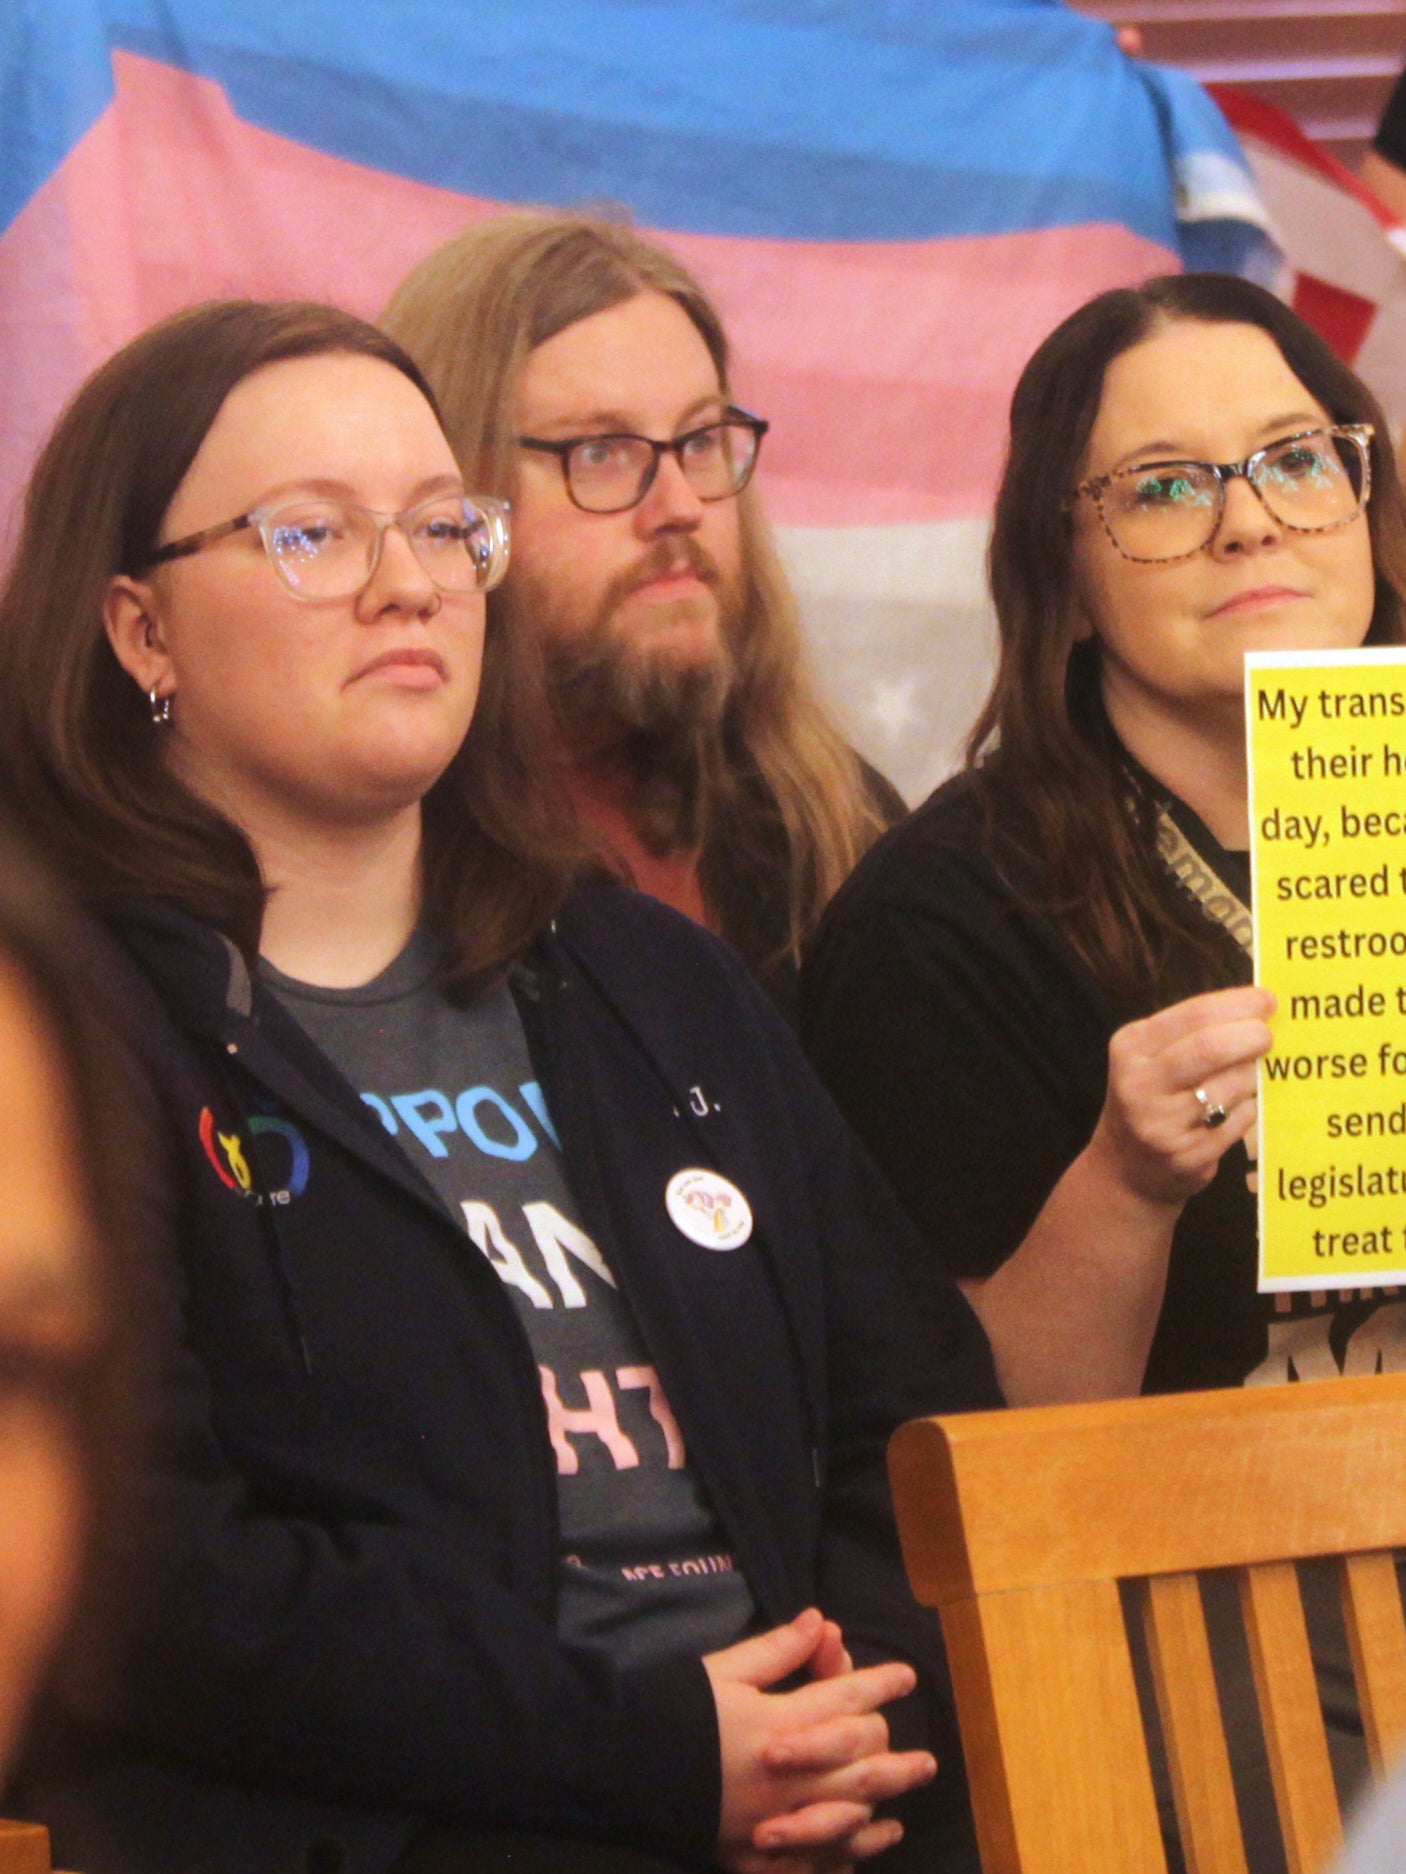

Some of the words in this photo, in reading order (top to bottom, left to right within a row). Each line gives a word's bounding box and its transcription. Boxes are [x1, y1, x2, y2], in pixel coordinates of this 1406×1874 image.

[1255, 689, 1308, 728] My
[1318, 689, 1406, 719] trans
[1291, 747, 1373, 779] their
[1261, 808, 1331, 848] day,
[1277, 864, 1389, 901] scared
[1291, 985, 1386, 1019] made
[1266, 1049, 1368, 1081] worse
[1312, 1226, 1393, 1258] treat
